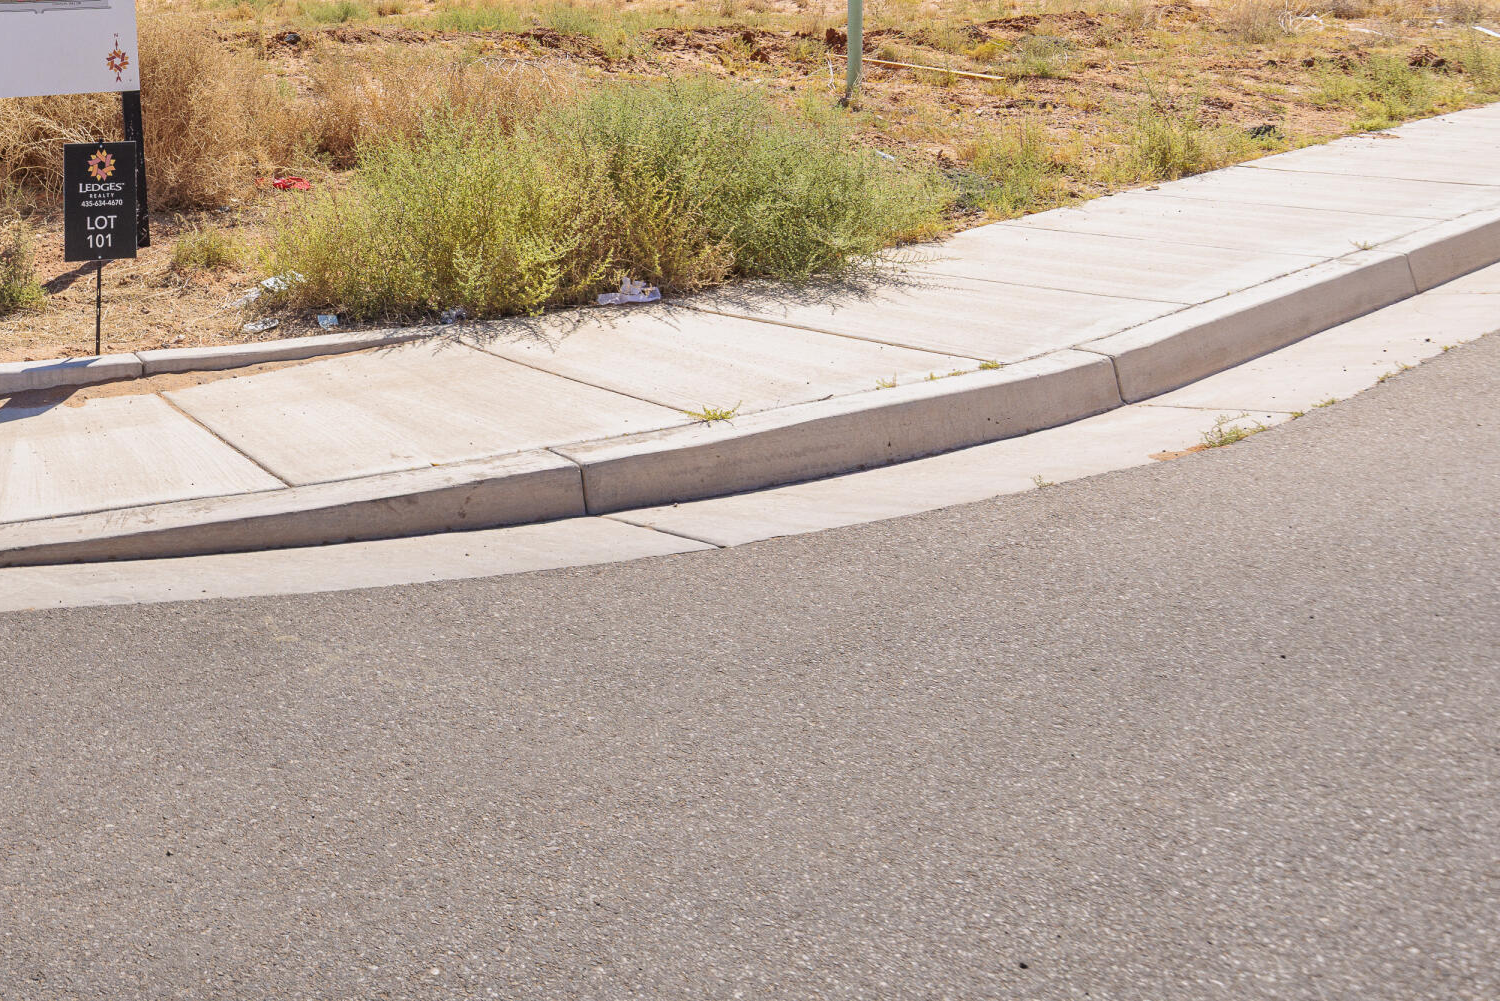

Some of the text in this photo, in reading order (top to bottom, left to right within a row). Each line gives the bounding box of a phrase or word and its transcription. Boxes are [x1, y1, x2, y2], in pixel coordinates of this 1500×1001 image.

[81, 199, 123, 207] 435-634-4670
[86, 215, 117, 230] LOT
[86, 233, 112, 248] 101
